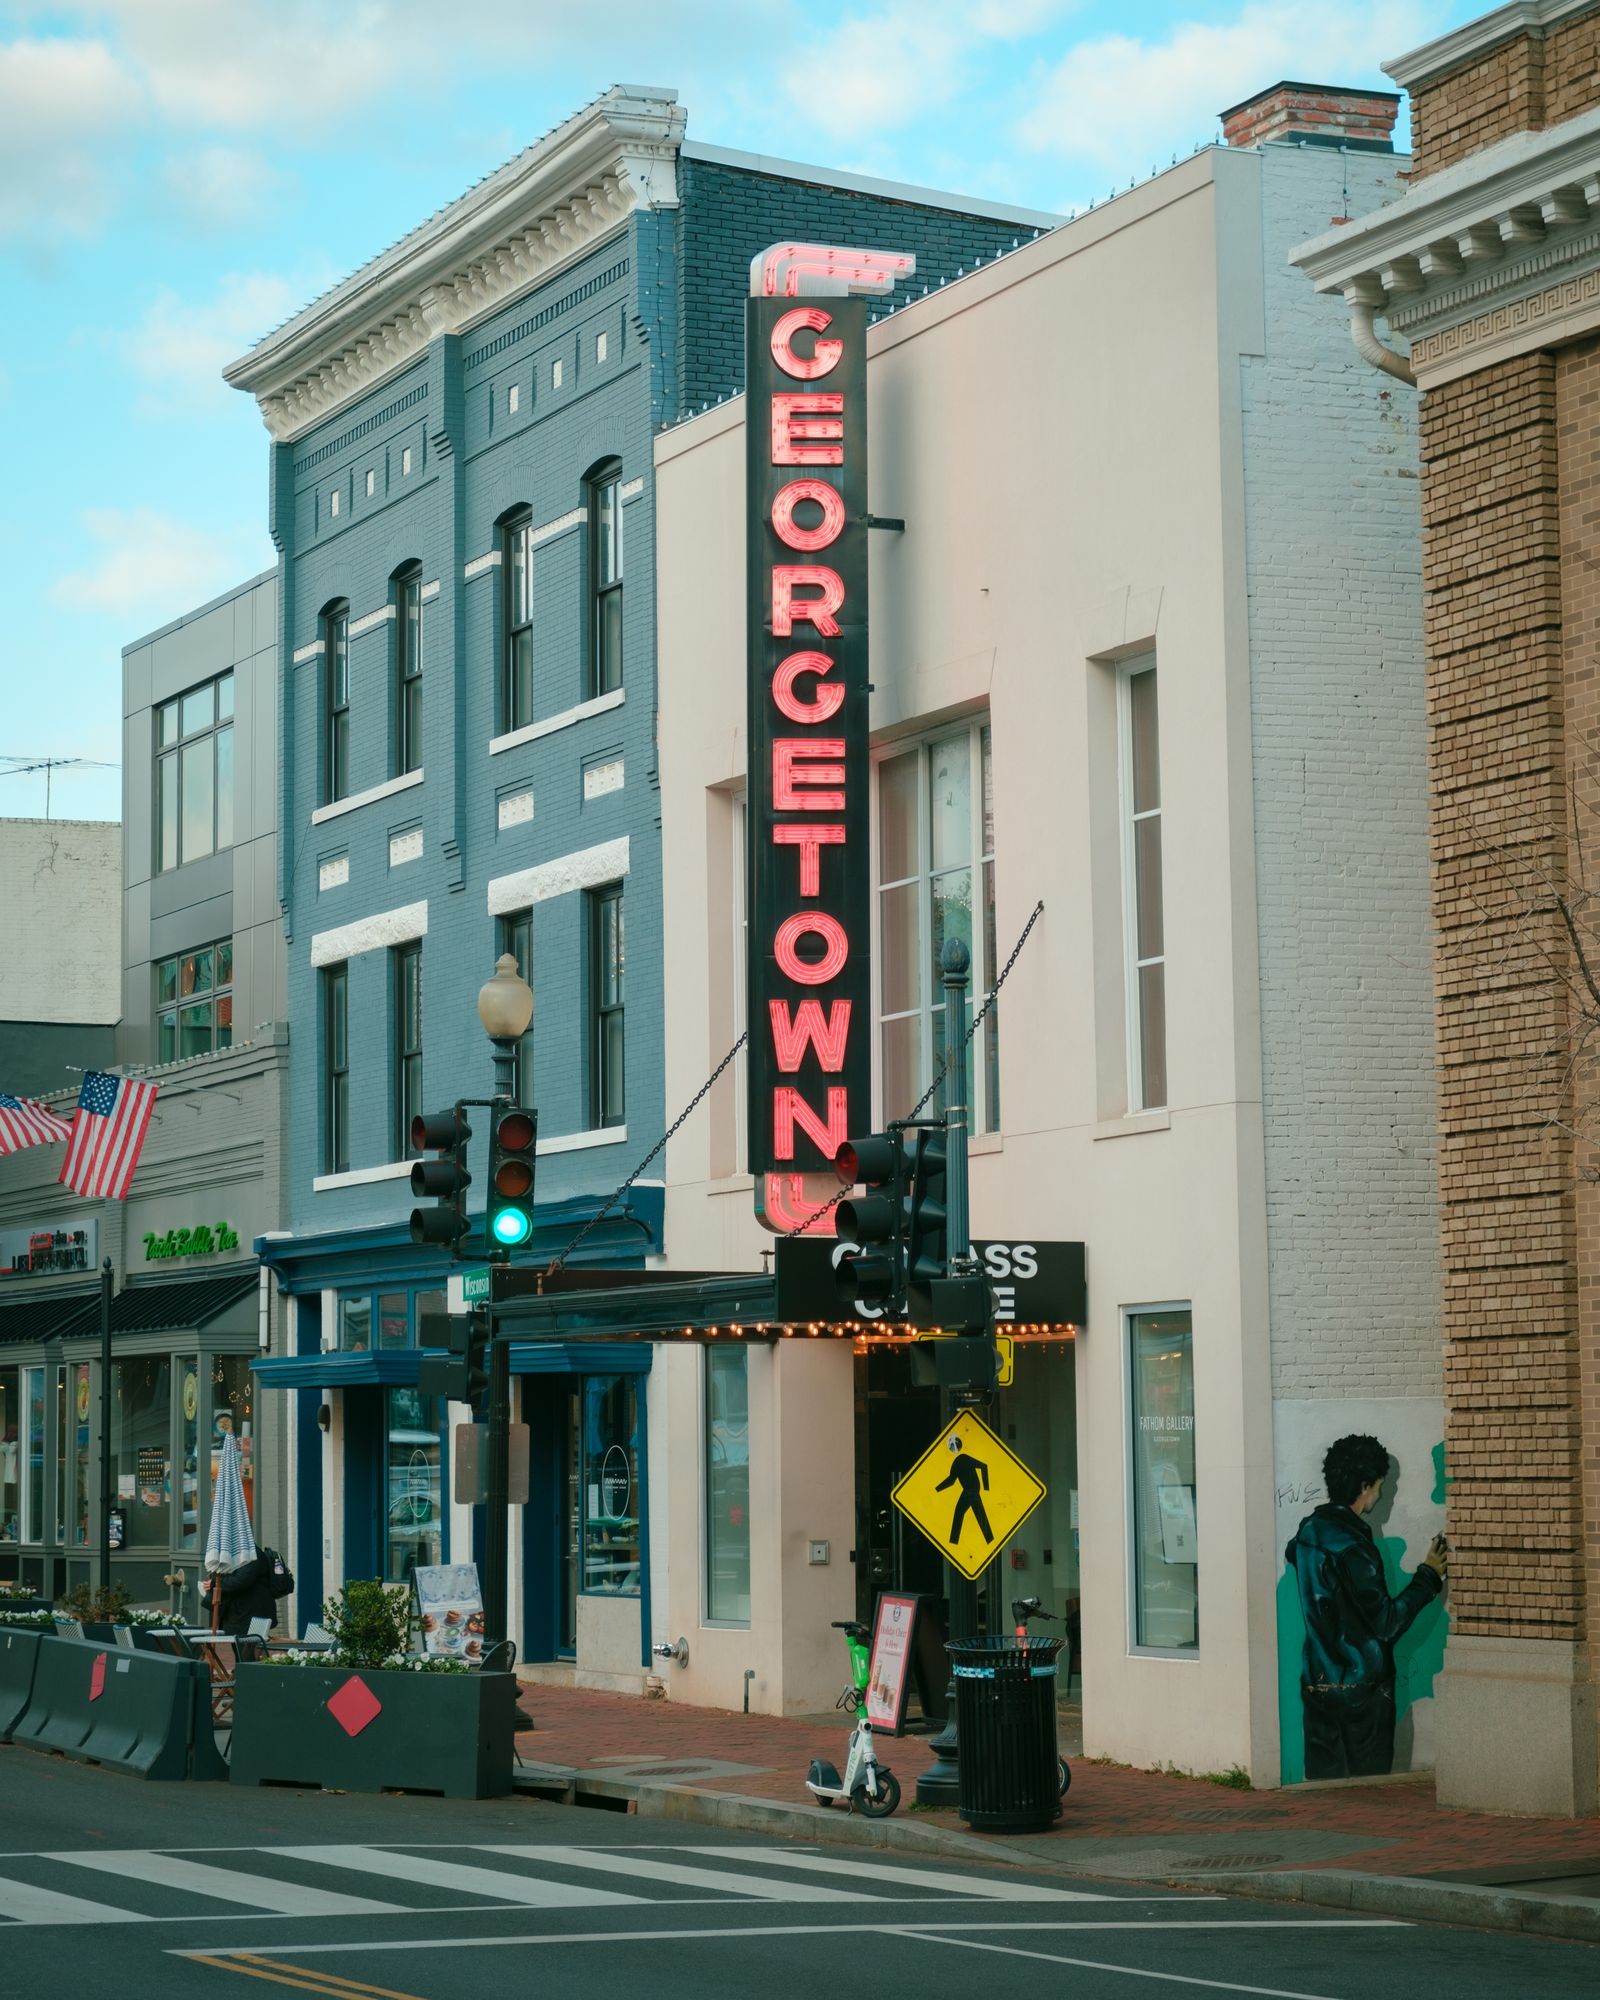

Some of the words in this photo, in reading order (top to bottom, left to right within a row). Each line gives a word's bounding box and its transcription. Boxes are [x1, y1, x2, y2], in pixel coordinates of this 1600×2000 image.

[768, 306, 851, 1161] GEORGETOWN
[175, 1225, 215, 1257] Bubble
[214, 1221, 239, 1252] Tea
[1139, 1415, 1164, 1431] FATHOM
[1166, 1415, 1194, 1431] GALLERY
